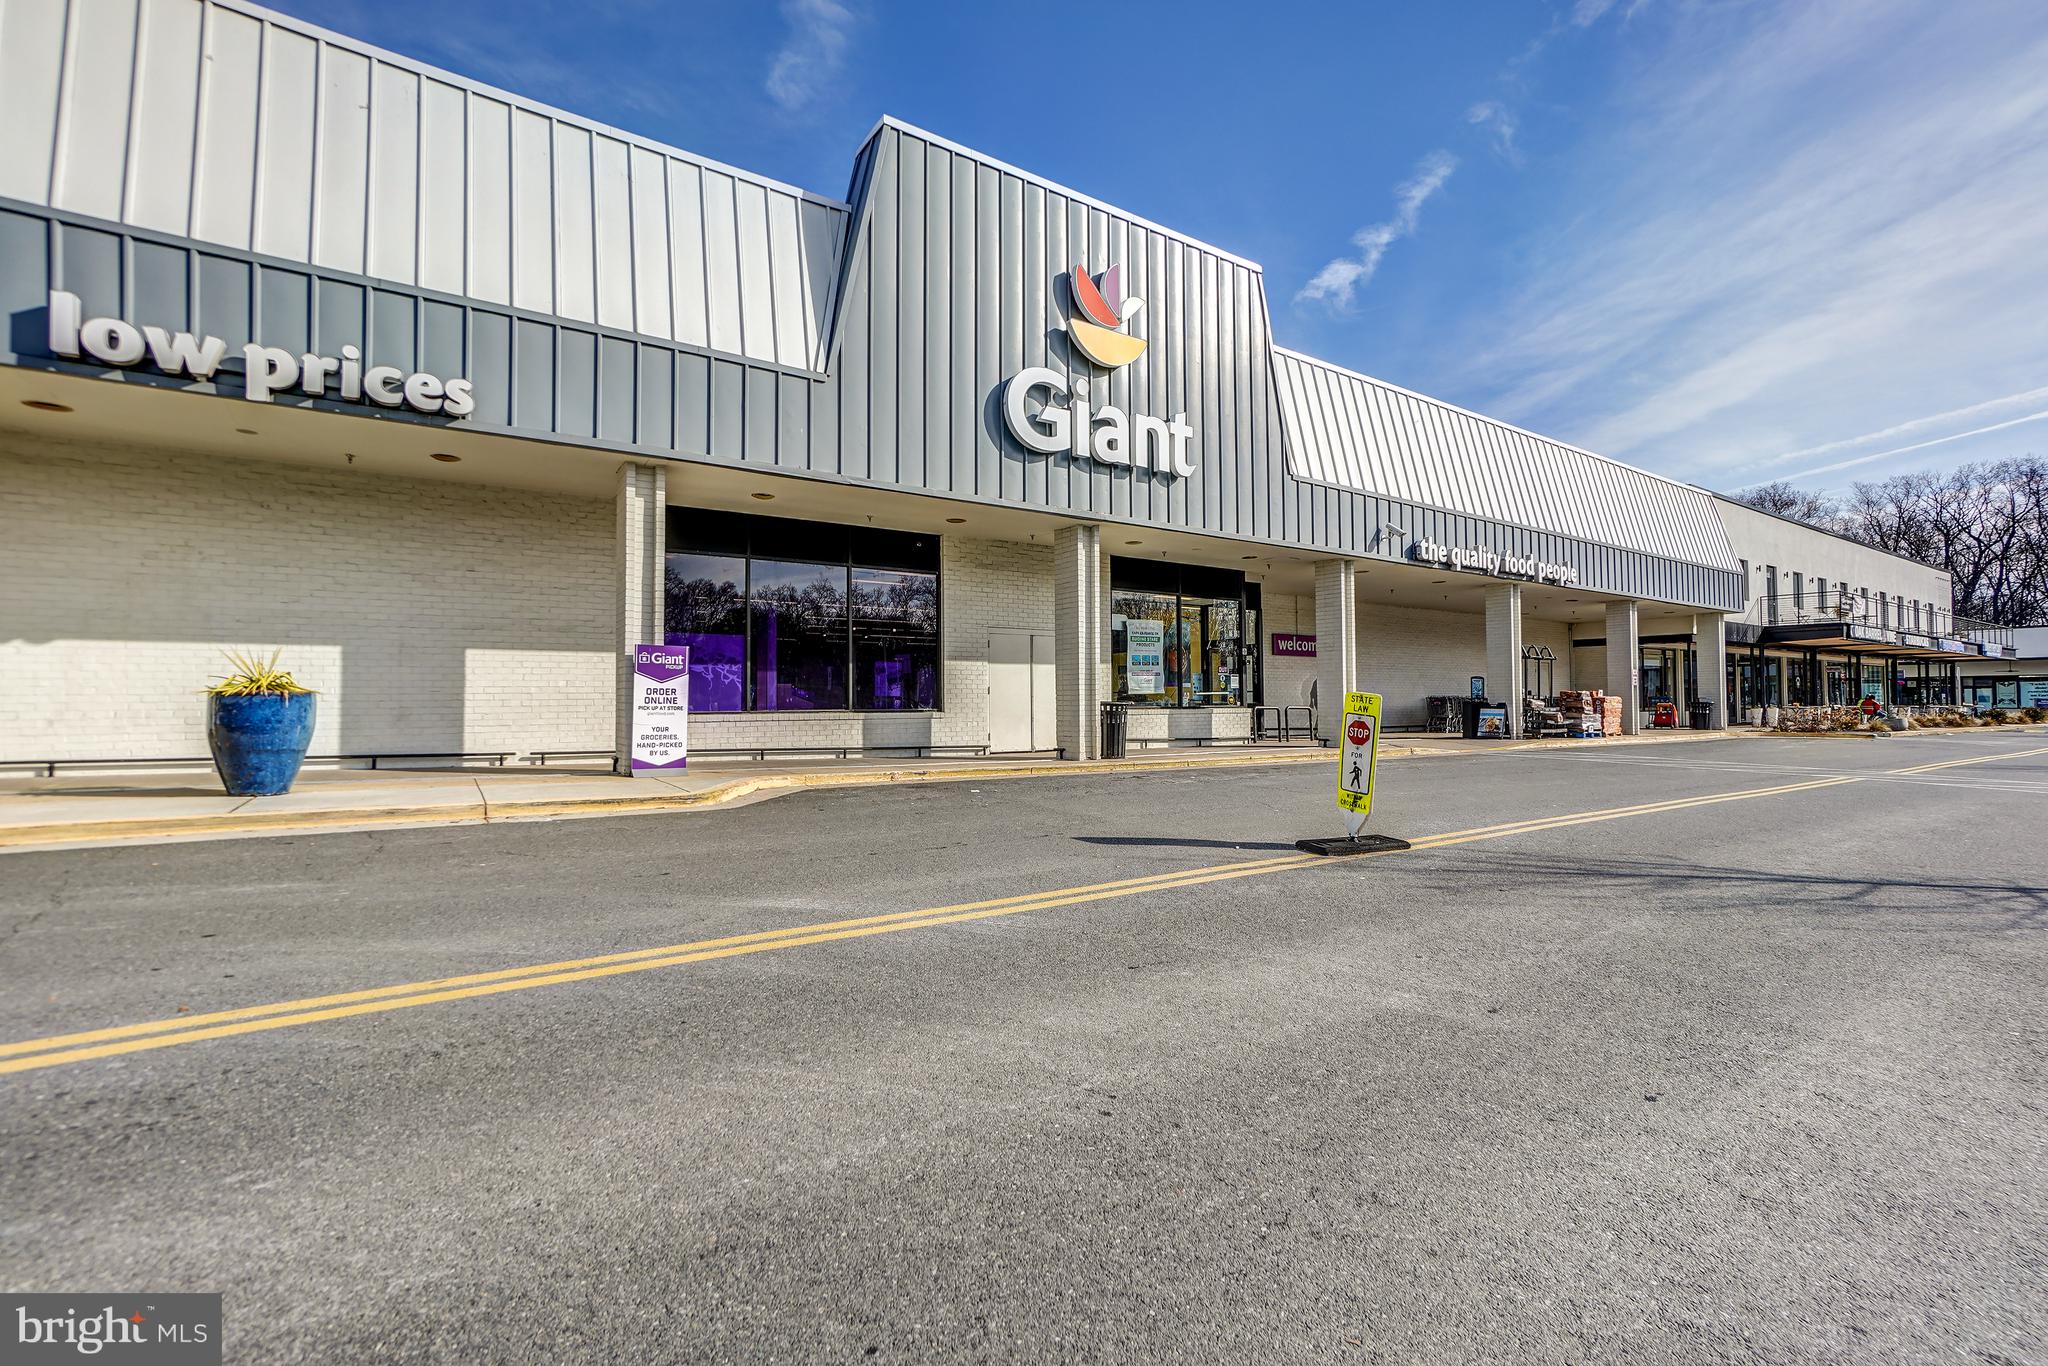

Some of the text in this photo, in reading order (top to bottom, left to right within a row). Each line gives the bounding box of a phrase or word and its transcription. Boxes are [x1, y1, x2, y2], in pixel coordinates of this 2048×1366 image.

[49, 289, 475, 417] low prices
[1003, 367, 1198, 478] Giant
[1418, 536, 1577, 587] the quality food people
[651, 652, 685, 665] Giant
[645, 687, 677, 696] ORDER
[644, 696, 678, 705] ONLINE
[1351, 694, 1373, 705] STATE
[1353, 704, 1369, 713] LAW
[1348, 727, 1370, 739] STOP
[636, 741, 683, 749] HAND-PICKED
[1350, 751, 1363, 759] FOR
